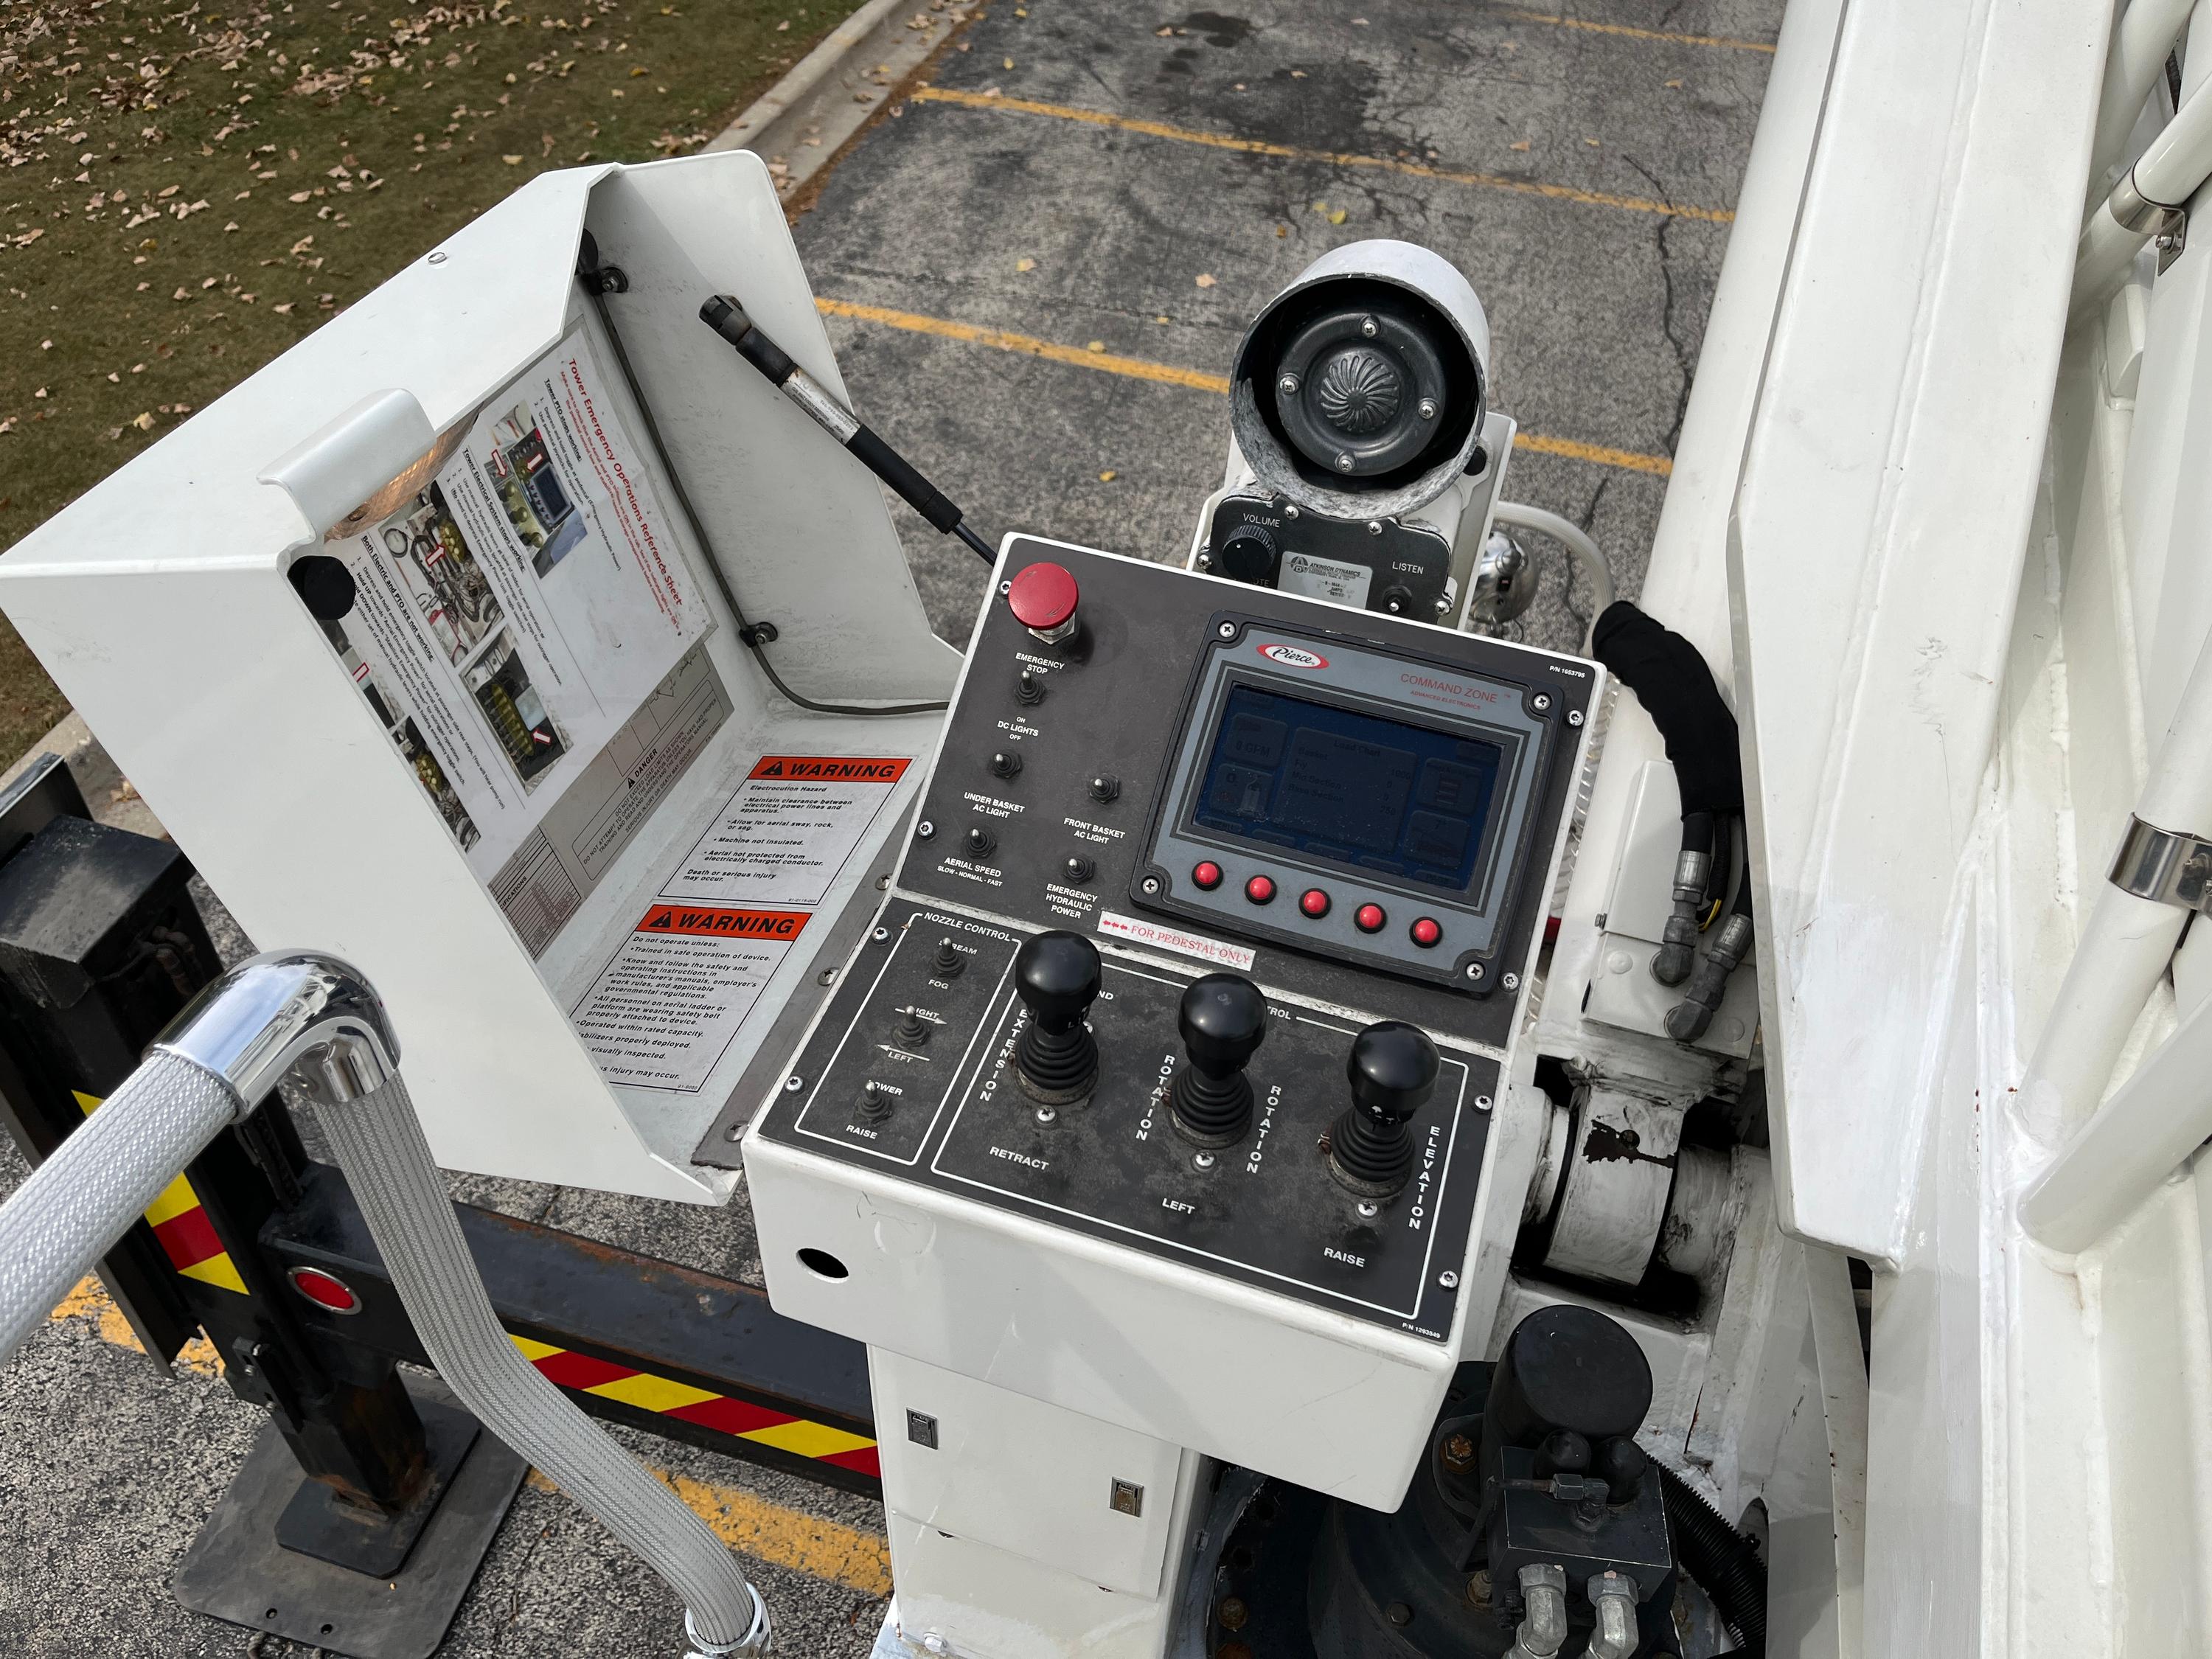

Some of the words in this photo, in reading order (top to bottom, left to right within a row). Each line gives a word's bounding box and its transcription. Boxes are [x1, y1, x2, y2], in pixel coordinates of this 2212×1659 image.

[543, 378, 556, 401] Tower
[553, 400, 562, 417] PTO
[559, 415, 569, 434] stops
[566, 433, 582, 462] working:
[568, 358, 586, 395] Tower
[583, 398, 615, 459] Emergency
[613, 462, 642, 521] Operations
[640, 523, 666, 574] Reference
[664, 575, 682, 605] Sheet
[462, 448, 475, 472] Tower
[472, 470, 490, 504] Electrical
[486, 501, 501, 527] System
[498, 526, 510, 546] stops
[508, 541, 525, 572] working:
[1243, 513, 1280, 528] VOLUME
[1310, 563, 1335, 572] ATKINSON
[1335, 567, 1360, 577] DYNAMICS
[1392, 560, 1425, 575] LISTEN
[361, 535, 373, 554] Both
[370, 553, 388, 581] Electric
[386, 580, 397, 594] and
[393, 593, 404, 610] PTO
[401, 608, 410, 622] are
[408, 620, 417, 633] not
[414, 632, 434, 662] working:
[1015, 652, 1065, 670] EMERGENCY
[1272, 647, 1312, 664] Pierce
[1026, 664, 1048, 675] STOP
[1401, 673, 1462, 696] COMMAND
[1464, 688, 1498, 703] ZONE
[1410, 691, 1440, 703] ADVANCED
[1441, 696, 1481, 711] ELECTRONICS
[997, 720, 1009, 729] DC
[1010, 723, 1039, 737] LIGHTS
[634, 748, 658, 777] DANGER
[790, 763, 896, 777] WARNING
[641, 795, 654, 813] INJURY
[659, 772, 672, 789] DEATH
[964, 792, 991, 805] UNDER
[992, 799, 1025, 813] BASKET
[972, 803, 984, 813] AC
[985, 807, 1010, 819] LIGHT
[1063, 817, 1091, 832] FRONT
[1092, 824, 1125, 840] BASKET
[1074, 830, 1086, 839] AC
[1087, 833, 1109, 844] LIGHT
[703, 855, 748, 863] electrically
[944, 857, 973, 871] AERIAL
[974, 865, 1001, 878] SPEED
[937, 865, 956, 875] SLOW
[958, 871, 983, 883] NORMAL
[987, 878, 1003, 887] FAST
[500, 875, 527, 910] CIFICATIONS
[1046, 883, 1098, 903] EMERGENCY
[1046, 893, 1093, 912] HYDRAULIC
[1051, 905, 1081, 919] POWER
[678, 914, 796, 934] WARNING
[923, 911, 964, 931] NOZZLE
[964, 922, 1012, 943] CONTROL
[939, 940, 978, 955] REAM
[1130, 925, 1155, 940] FOR
[1155, 931, 1215, 955] PEDESTAL
[1219, 946, 1251, 964] ONLY
[615, 972, 673, 981] manufacturer's
[675, 976, 709, 984] manuals,
[712, 979, 757, 987] employer's
[928, 978, 949, 990] FOG
[604, 986, 659, 995] governmental
[659, 990, 706, 998] regulations.
[915, 1007, 940, 1019] IGHT
[1267, 1006, 1291, 1020] TROL
[579, 1019, 617, 1029] Operated
[667, 1029, 703, 1038] capacity.
[578, 1032, 613, 1041] abilizers
[613, 1037, 650, 1046] properly
[651, 1039, 690, 1048] deployed.
[591, 1046, 623, 1056] visually
[623, 1049, 666, 1059] inspected.
[888, 1051, 914, 1063] LEFT
[980, 1009, 1028, 1102] EXTENSION
[609, 1065, 634, 1076] injury
[870, 1080, 903, 1096] OWER
[1135, 1054, 1175, 1141] ROTATION
[846, 1124, 877, 1140] RAISE
[1246, 1085, 1281, 1174] ROTATION
[990, 1146, 1049, 1170] RETRACT
[1408, 1126, 1440, 1230] ELEVATION
[1161, 1197, 1195, 1215] LEFT
[1324, 1246, 1366, 1268] RAISE
[1402, 1322, 1414, 1330] P/N
